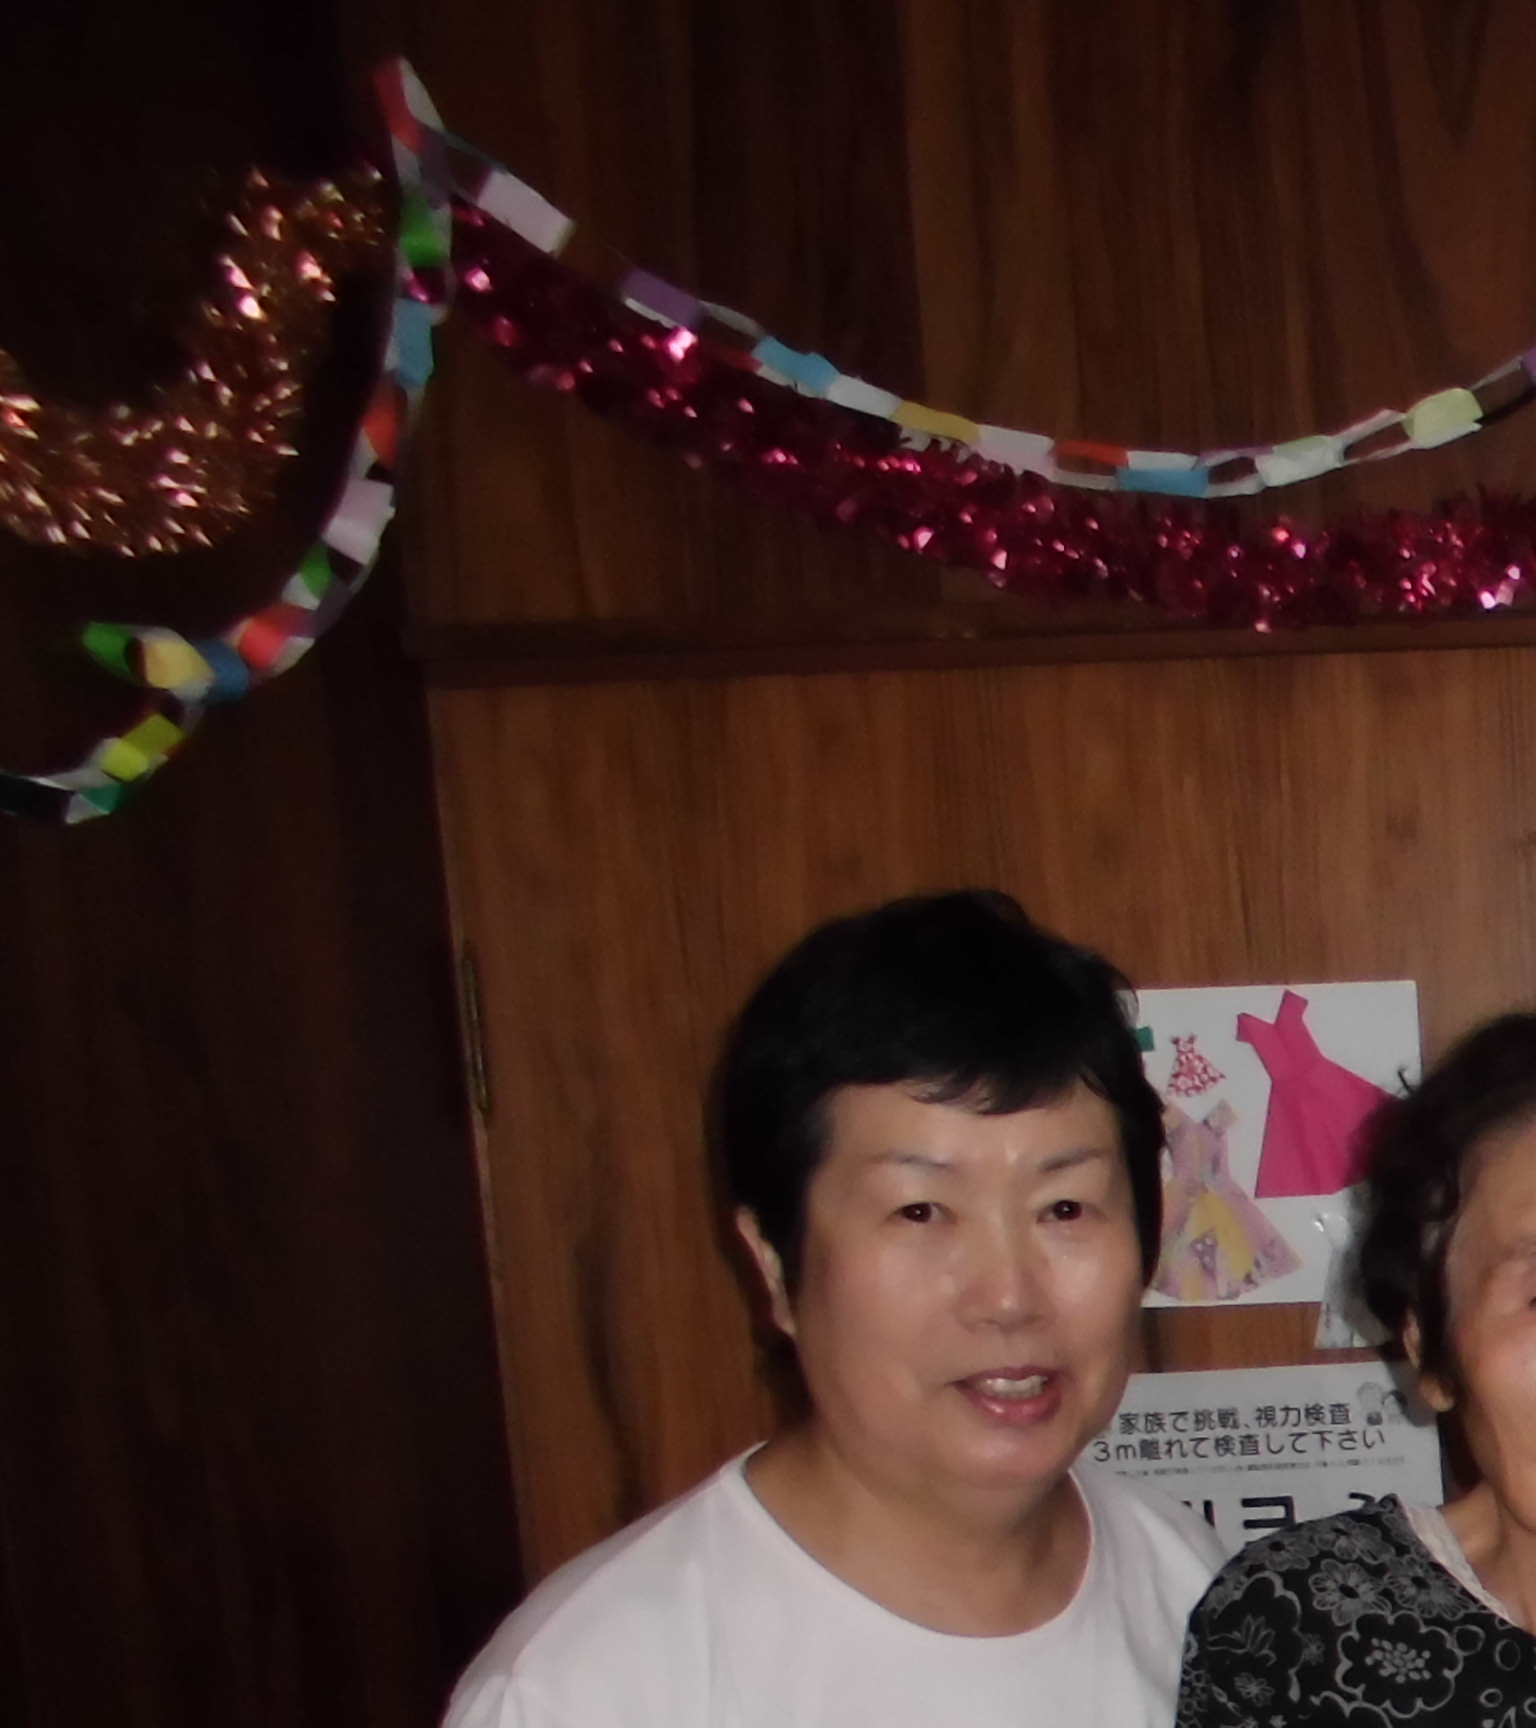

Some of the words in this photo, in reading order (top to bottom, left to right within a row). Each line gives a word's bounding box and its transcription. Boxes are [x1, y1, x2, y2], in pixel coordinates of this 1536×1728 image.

[1118, 1402, 1351, 1435] 家族で挑戦、視力検査
